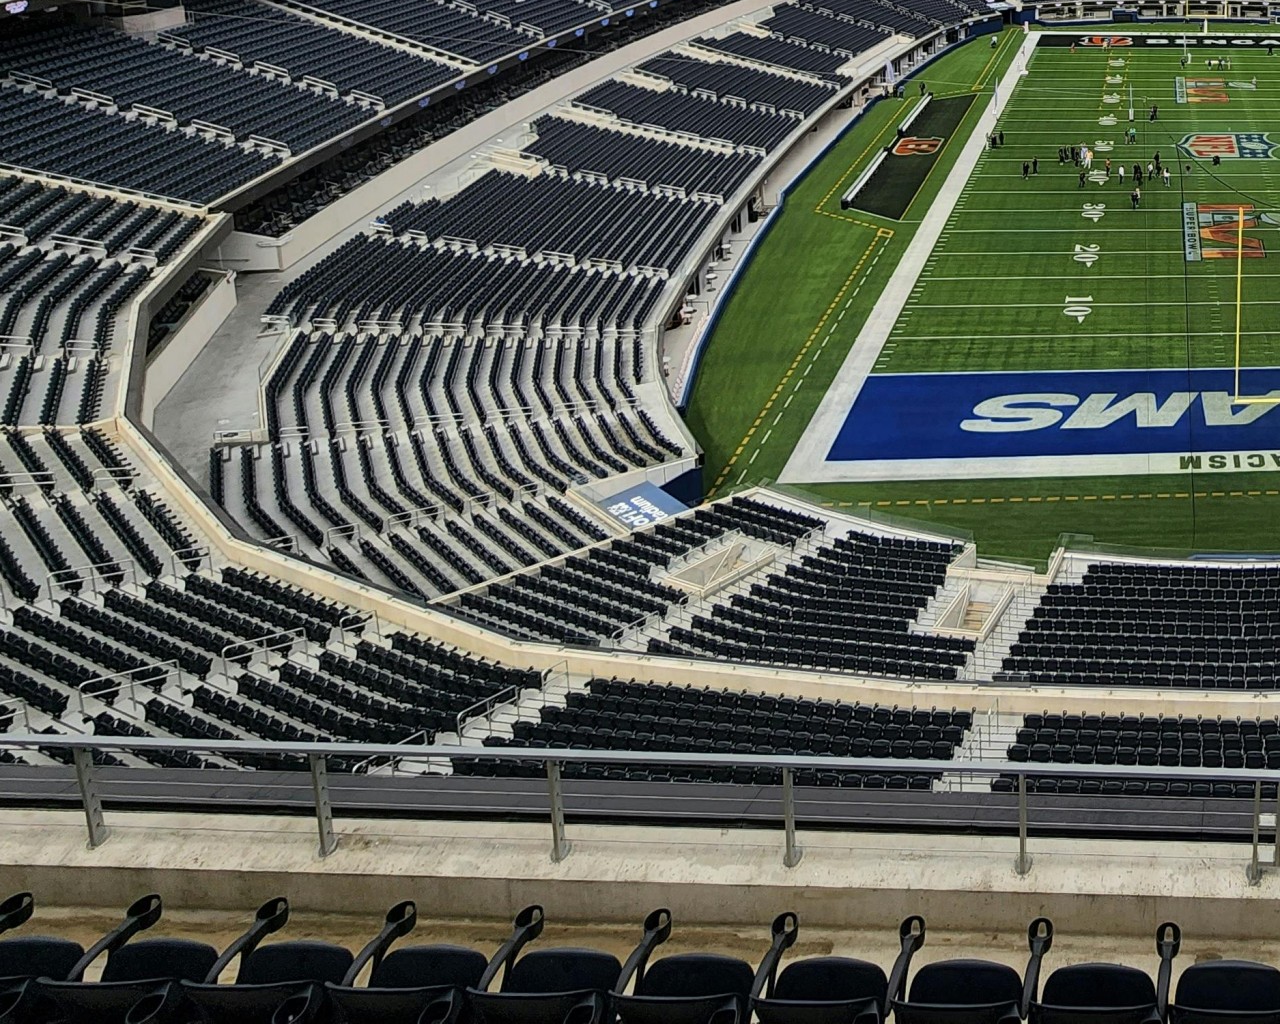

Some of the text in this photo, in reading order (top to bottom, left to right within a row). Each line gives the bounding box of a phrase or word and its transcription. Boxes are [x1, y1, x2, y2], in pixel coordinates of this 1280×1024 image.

[1189, 136, 1236, 156] NFL
[1081, 203, 1106, 217] 30
[1073, 243, 1100, 262] 20
[1063, 295, 1094, 317] 10
[630, 496, 669, 521] tadium
